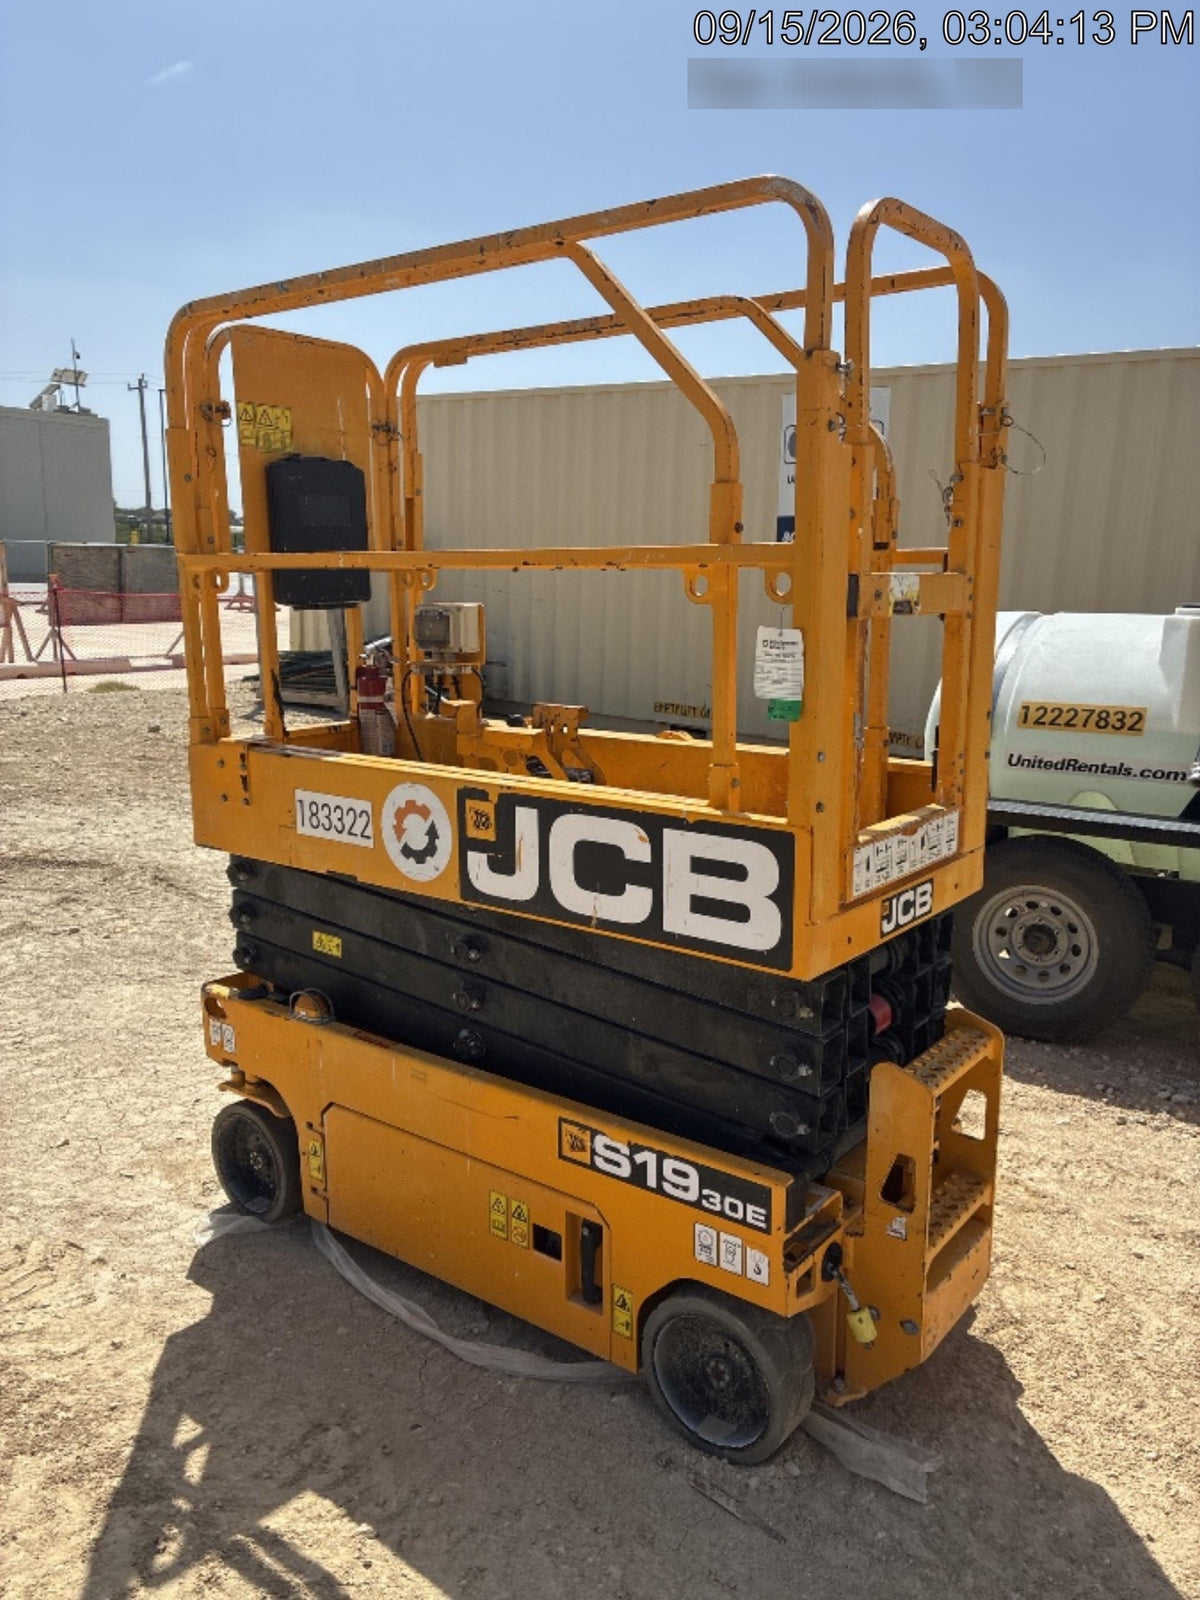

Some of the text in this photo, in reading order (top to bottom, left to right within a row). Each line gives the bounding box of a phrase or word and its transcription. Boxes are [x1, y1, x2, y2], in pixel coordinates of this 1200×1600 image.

[1020, 705, 1143, 732] 12227832
[1007, 753, 1188, 782] UnitedRentals.com
[298, 800, 372, 840] 183322
[466, 806, 783, 952] JCB
[882, 883, 932, 934] JCB
